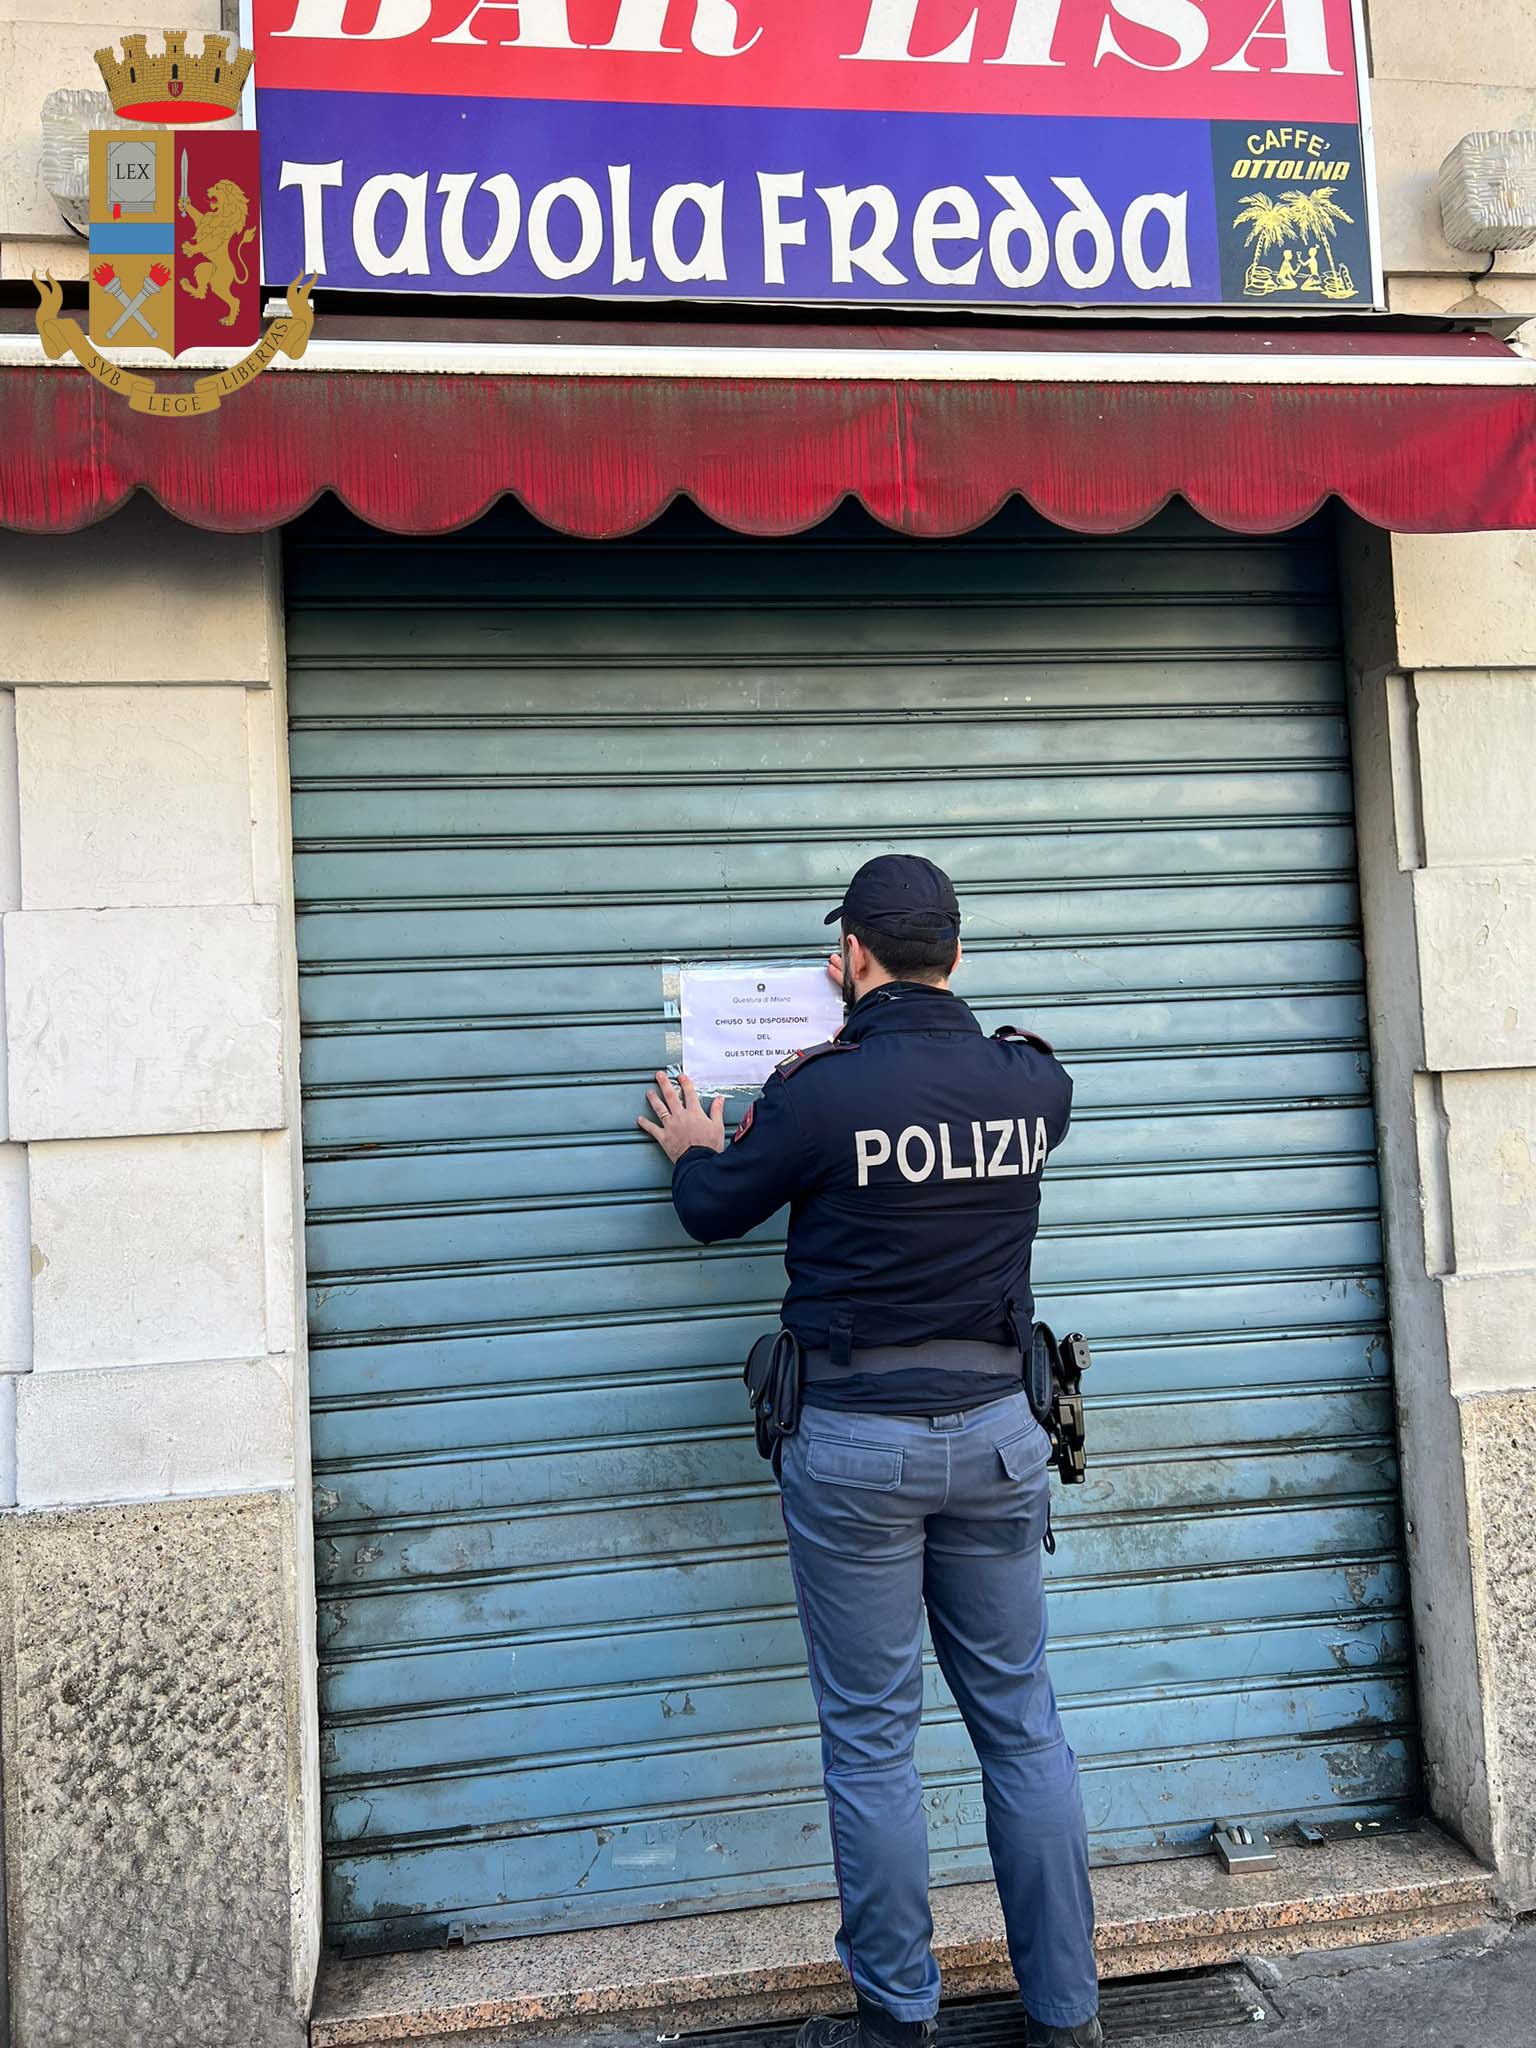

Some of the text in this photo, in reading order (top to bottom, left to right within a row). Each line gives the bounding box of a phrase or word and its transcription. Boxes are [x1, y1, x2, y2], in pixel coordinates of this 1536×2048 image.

[839, 0, 1344, 76] LISA
[1231, 159, 1350, 181] OTTOLINA
[279, 159, 727, 286] Tavola
[715, 1018, 743, 1026] CHIUSO
[855, 1117, 1048, 1187] POLIZIA
